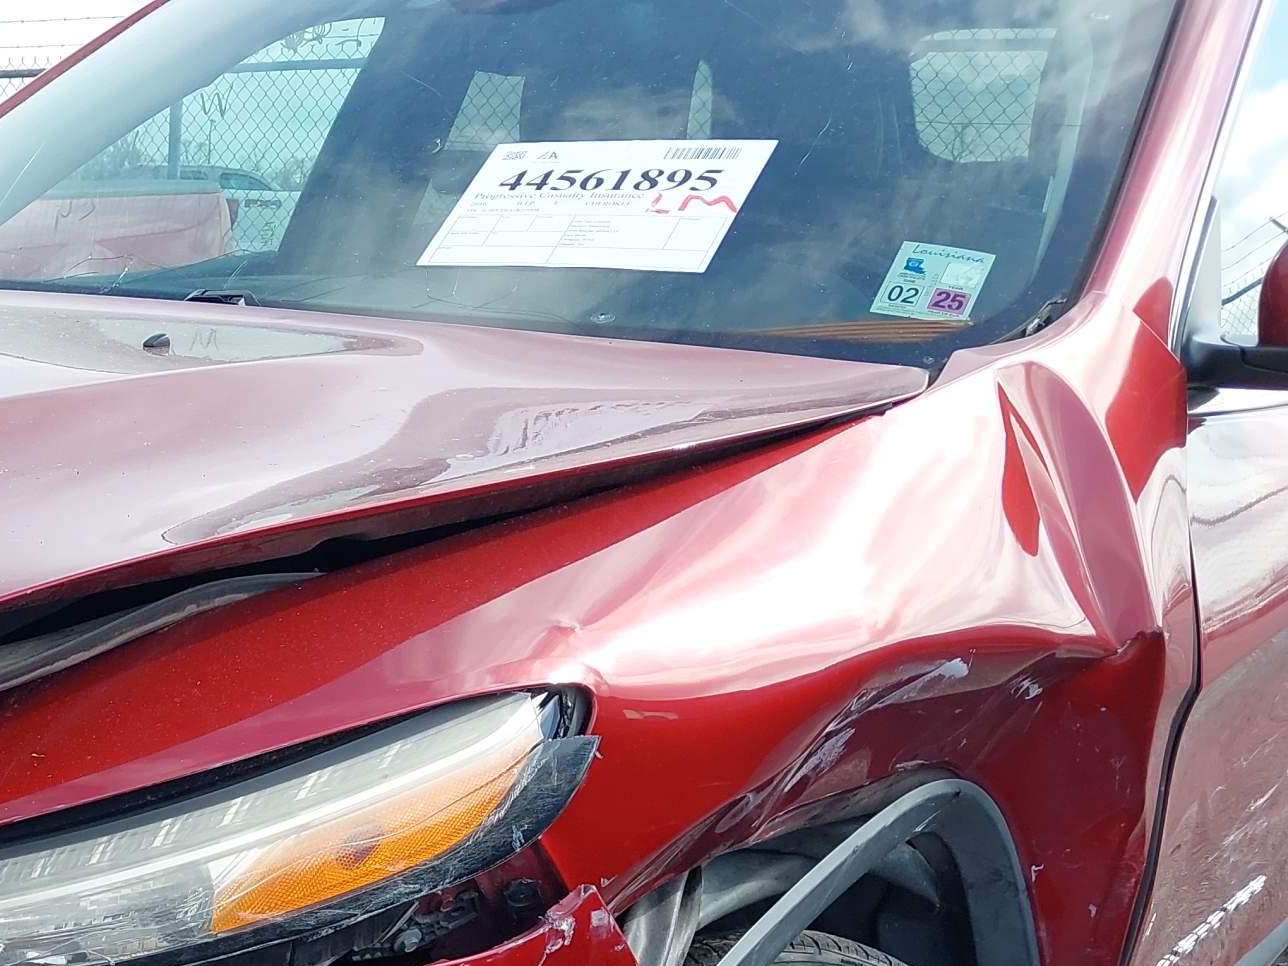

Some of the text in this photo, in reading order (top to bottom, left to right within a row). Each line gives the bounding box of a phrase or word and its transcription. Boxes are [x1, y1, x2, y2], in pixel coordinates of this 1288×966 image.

[498, 168, 722, 191] 44561895
[912, 244, 984, 263] Louisiana
[888, 285, 919, 304] 02
[932, 291, 966, 310] 25
